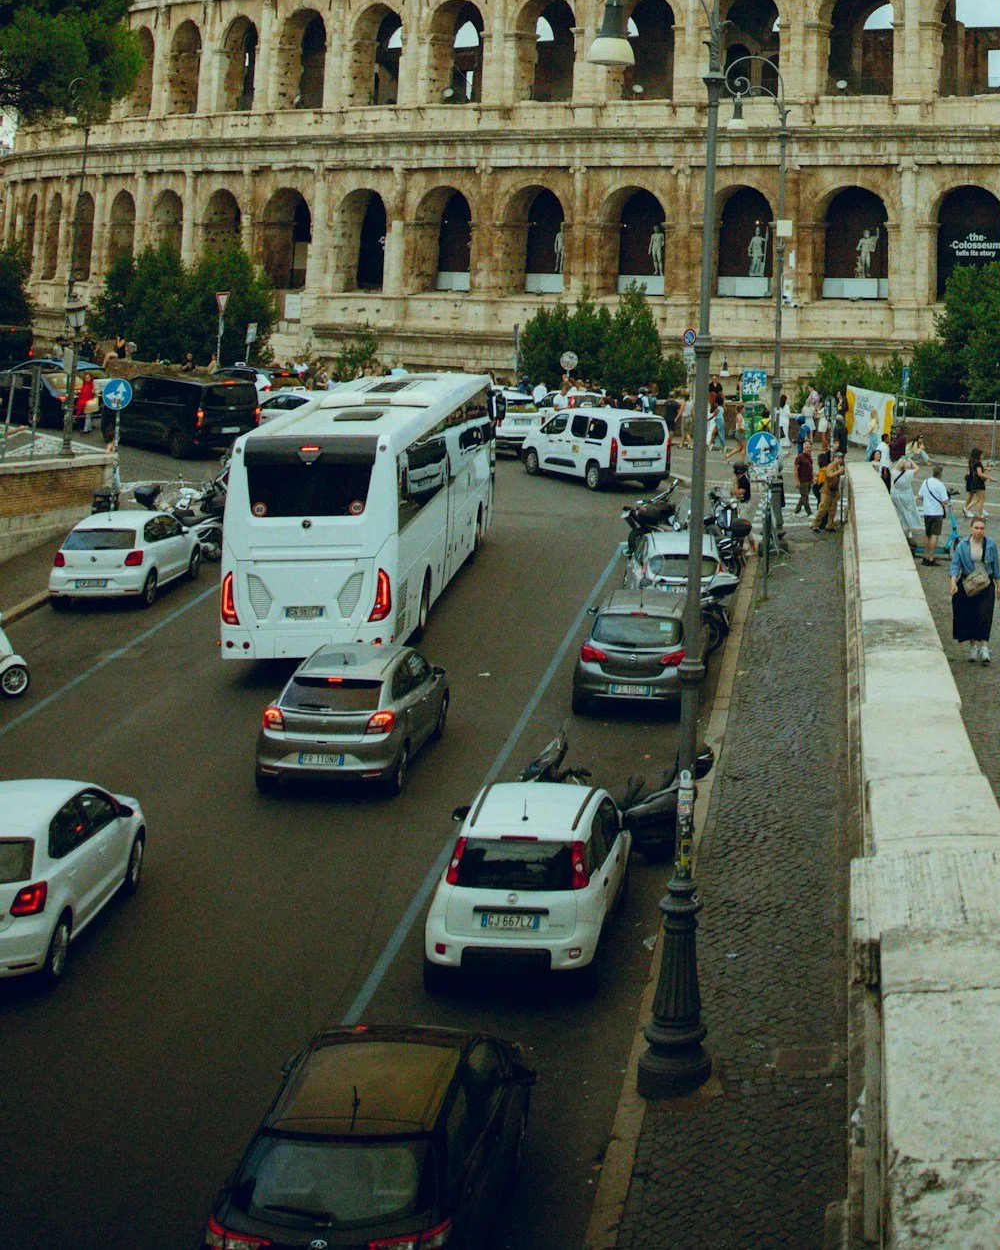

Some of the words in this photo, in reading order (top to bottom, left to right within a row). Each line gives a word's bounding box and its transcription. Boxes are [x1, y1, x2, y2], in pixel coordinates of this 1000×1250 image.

[968, 233, 984, 241] the
[952, 240, 1000, 250] Colosseum
[502, 915, 533, 928] 667LZ
